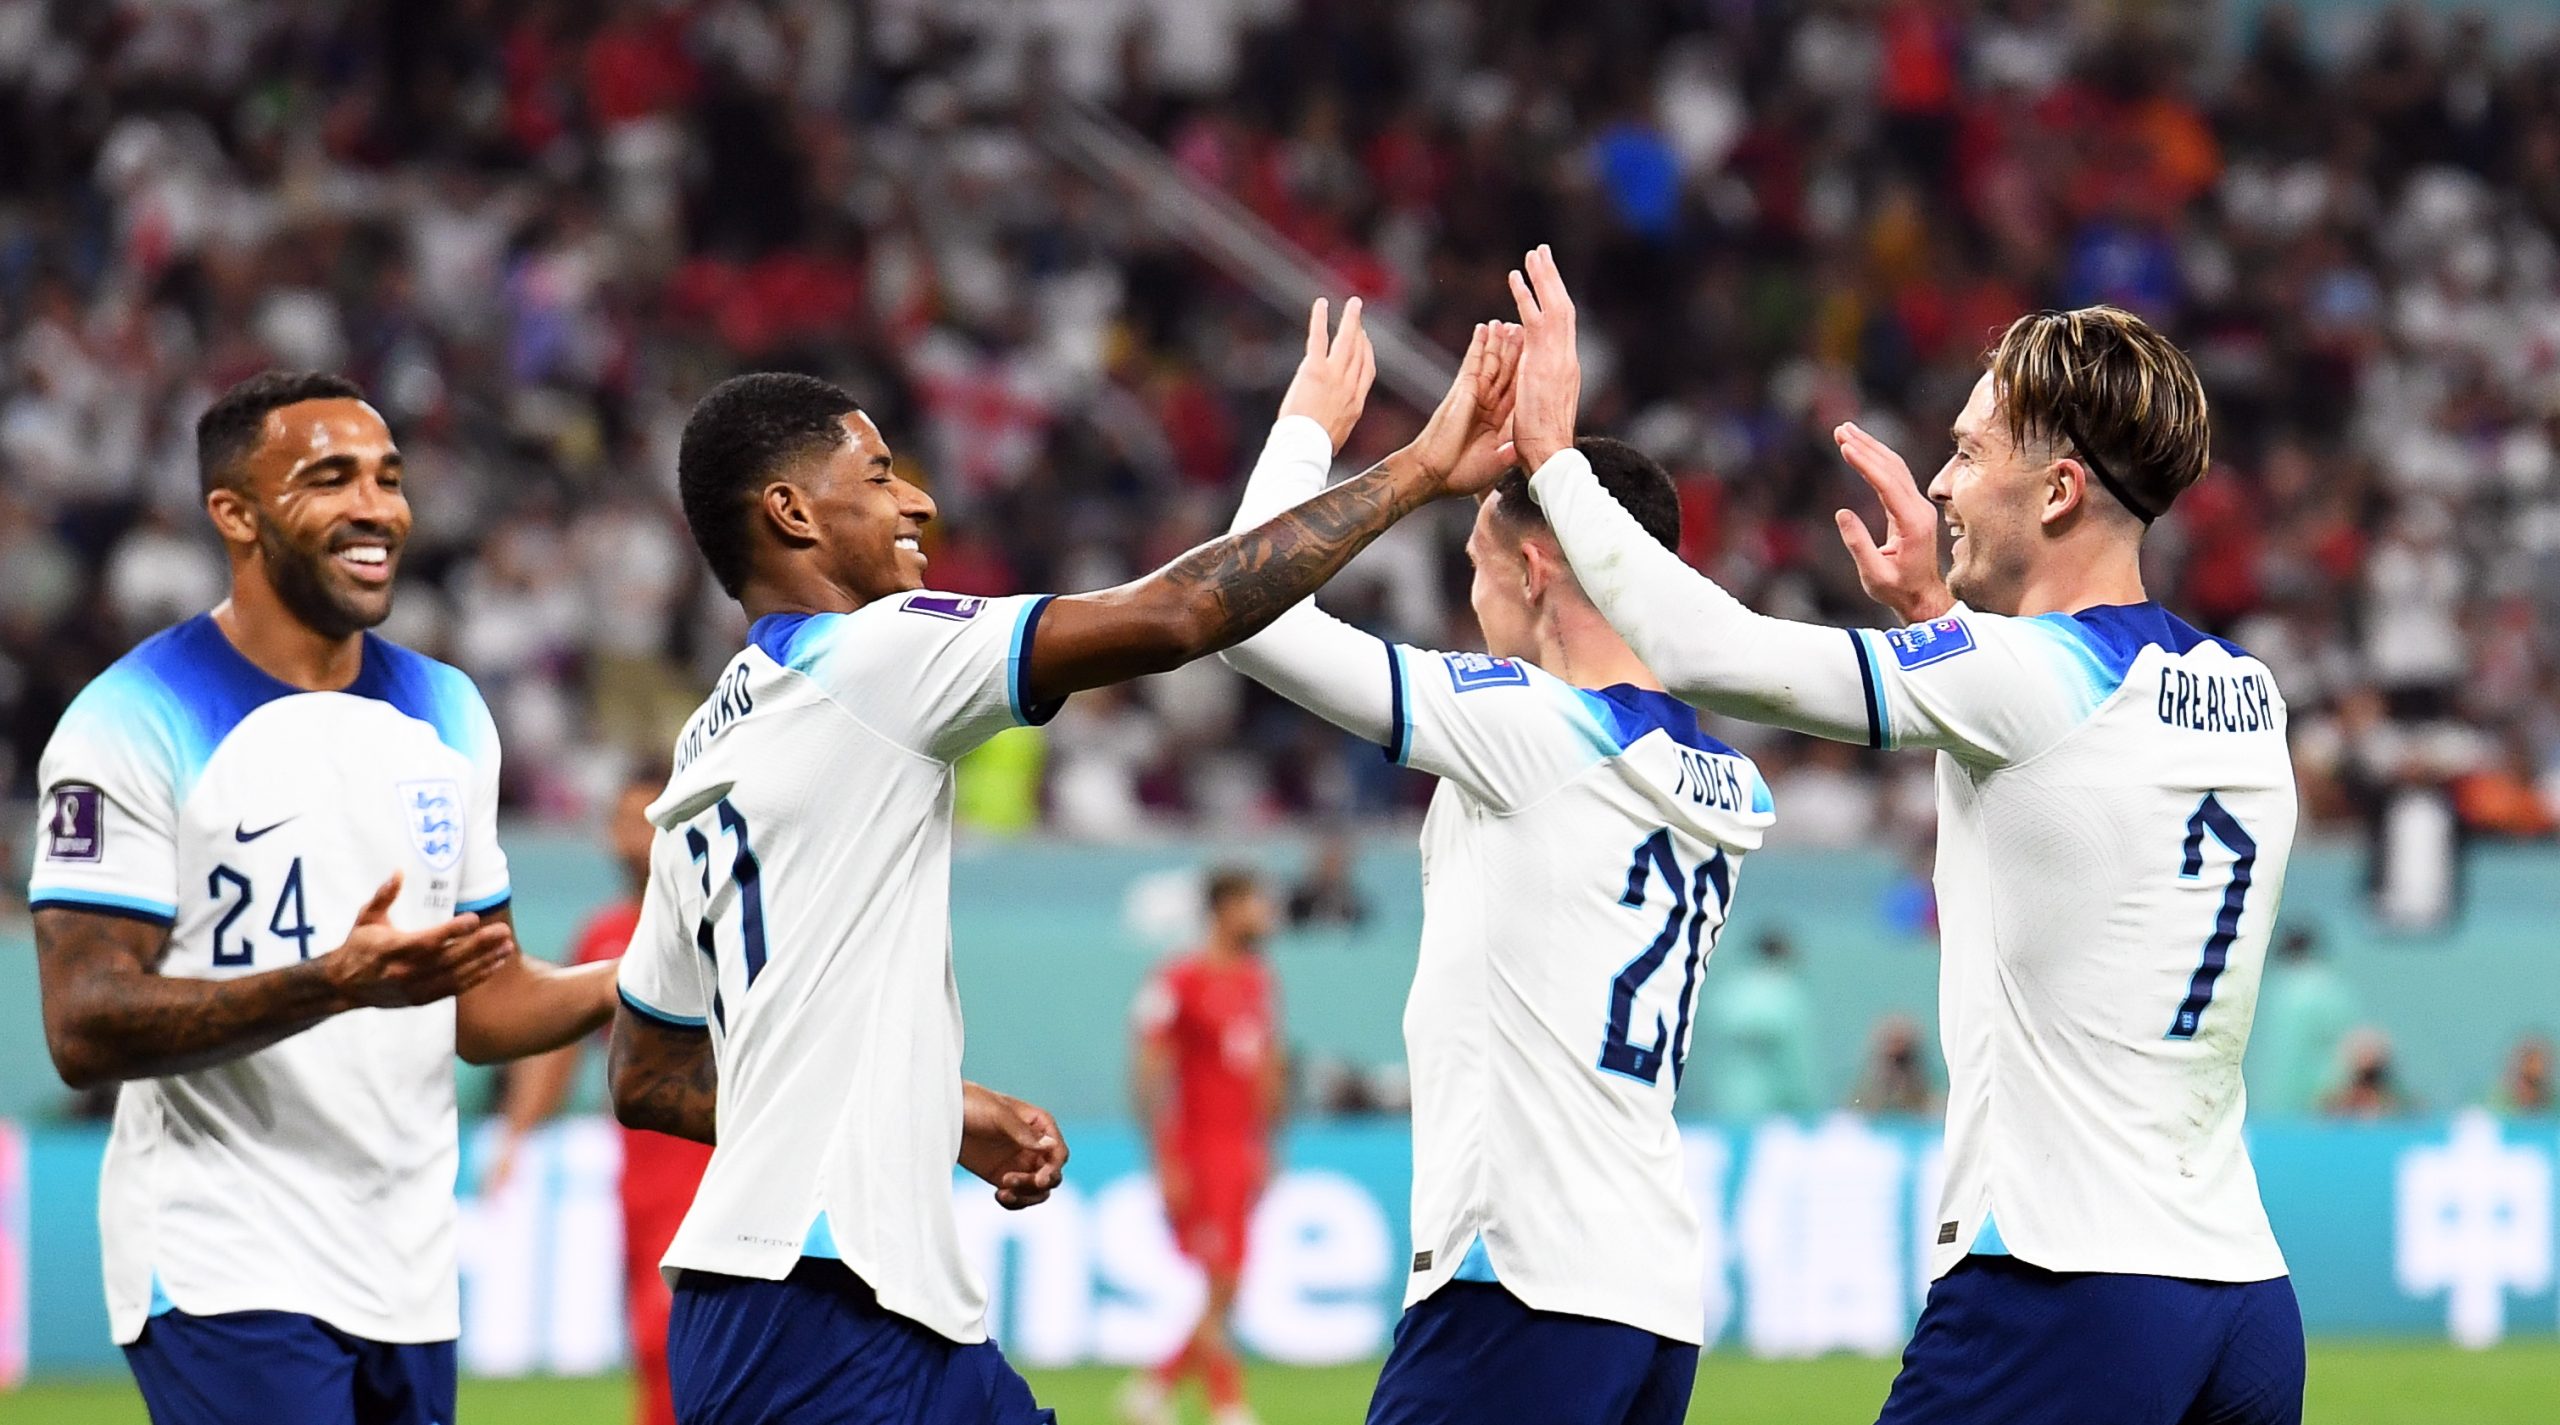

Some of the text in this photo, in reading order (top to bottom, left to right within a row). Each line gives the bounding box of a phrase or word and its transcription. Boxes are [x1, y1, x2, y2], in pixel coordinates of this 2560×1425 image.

[207, 856, 316, 967] 24
[686, 797, 771, 1040] 11
[2163, 788, 2257, 1040] 7
